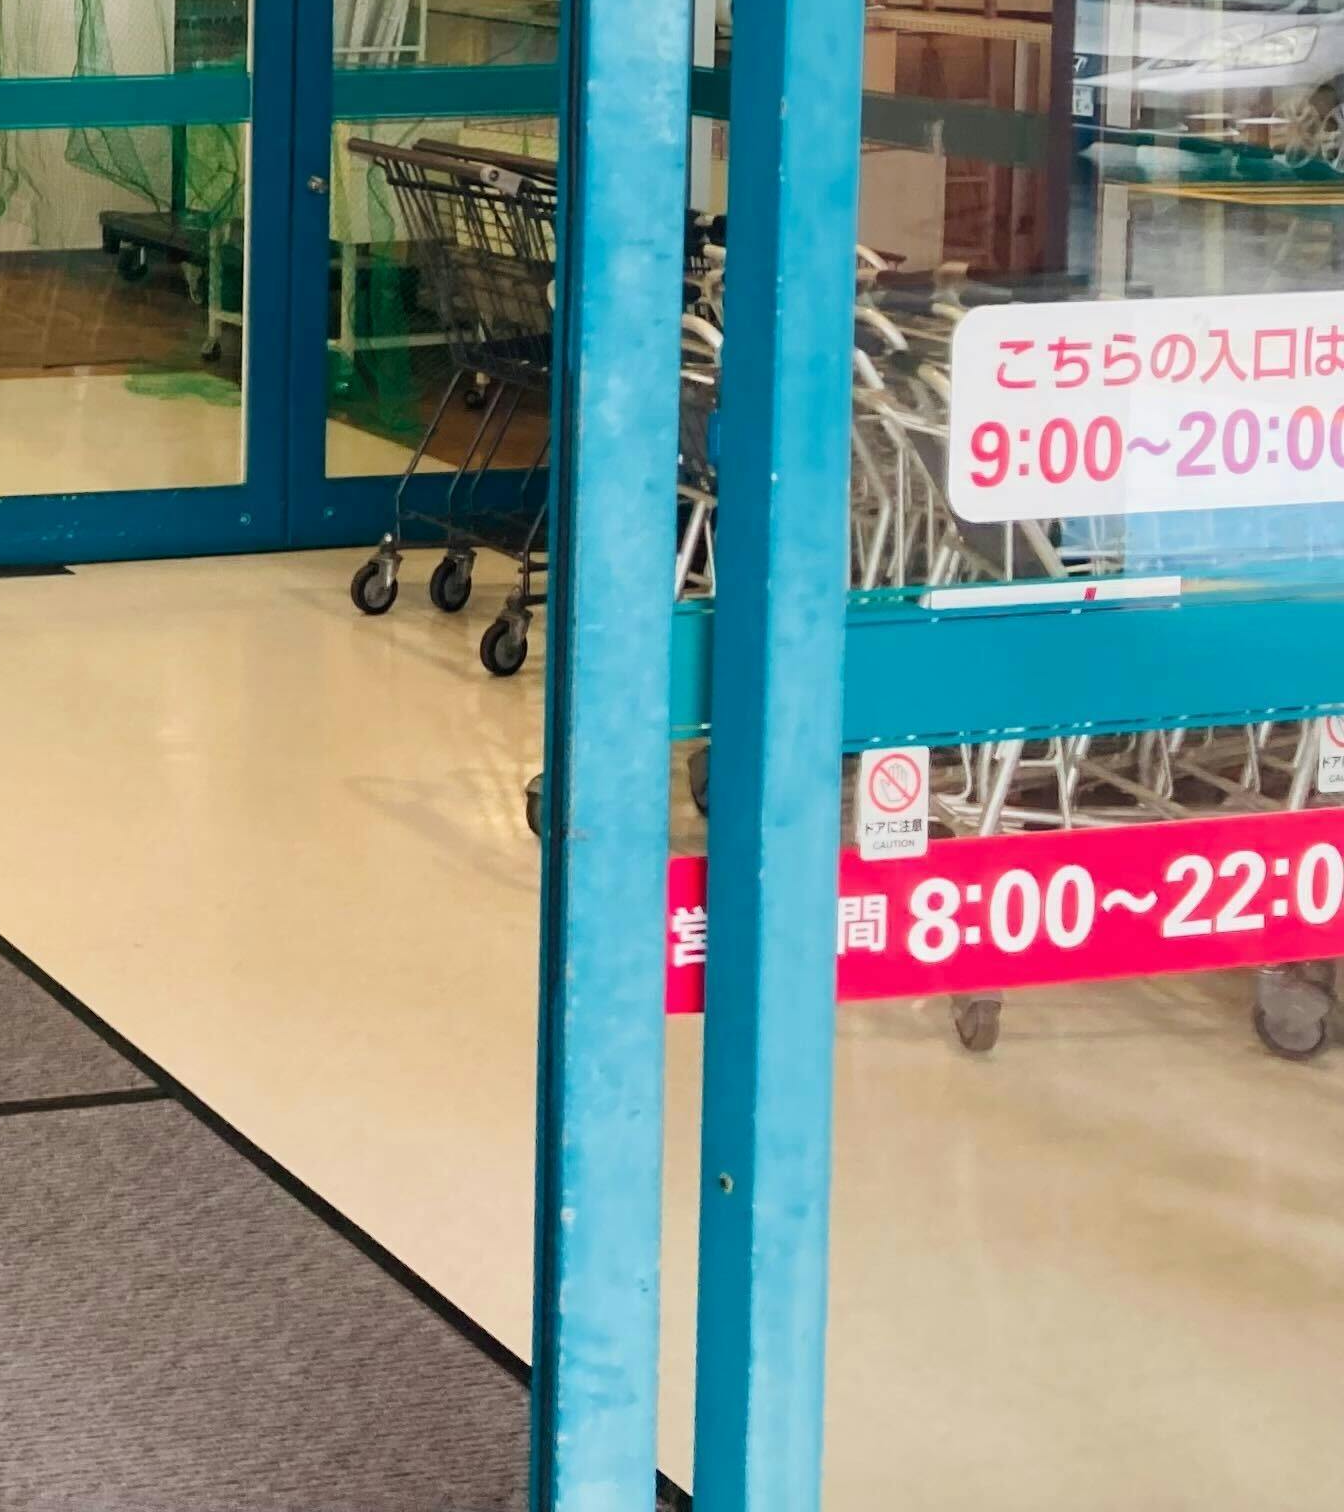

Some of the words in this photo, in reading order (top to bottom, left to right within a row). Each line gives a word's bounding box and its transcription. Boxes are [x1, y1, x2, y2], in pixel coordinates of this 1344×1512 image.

[996, 325, 1344, 389] こちらの入口は
[864, 818, 924, 834] ドアに注意
[872, 839, 916, 850] CAUTION
